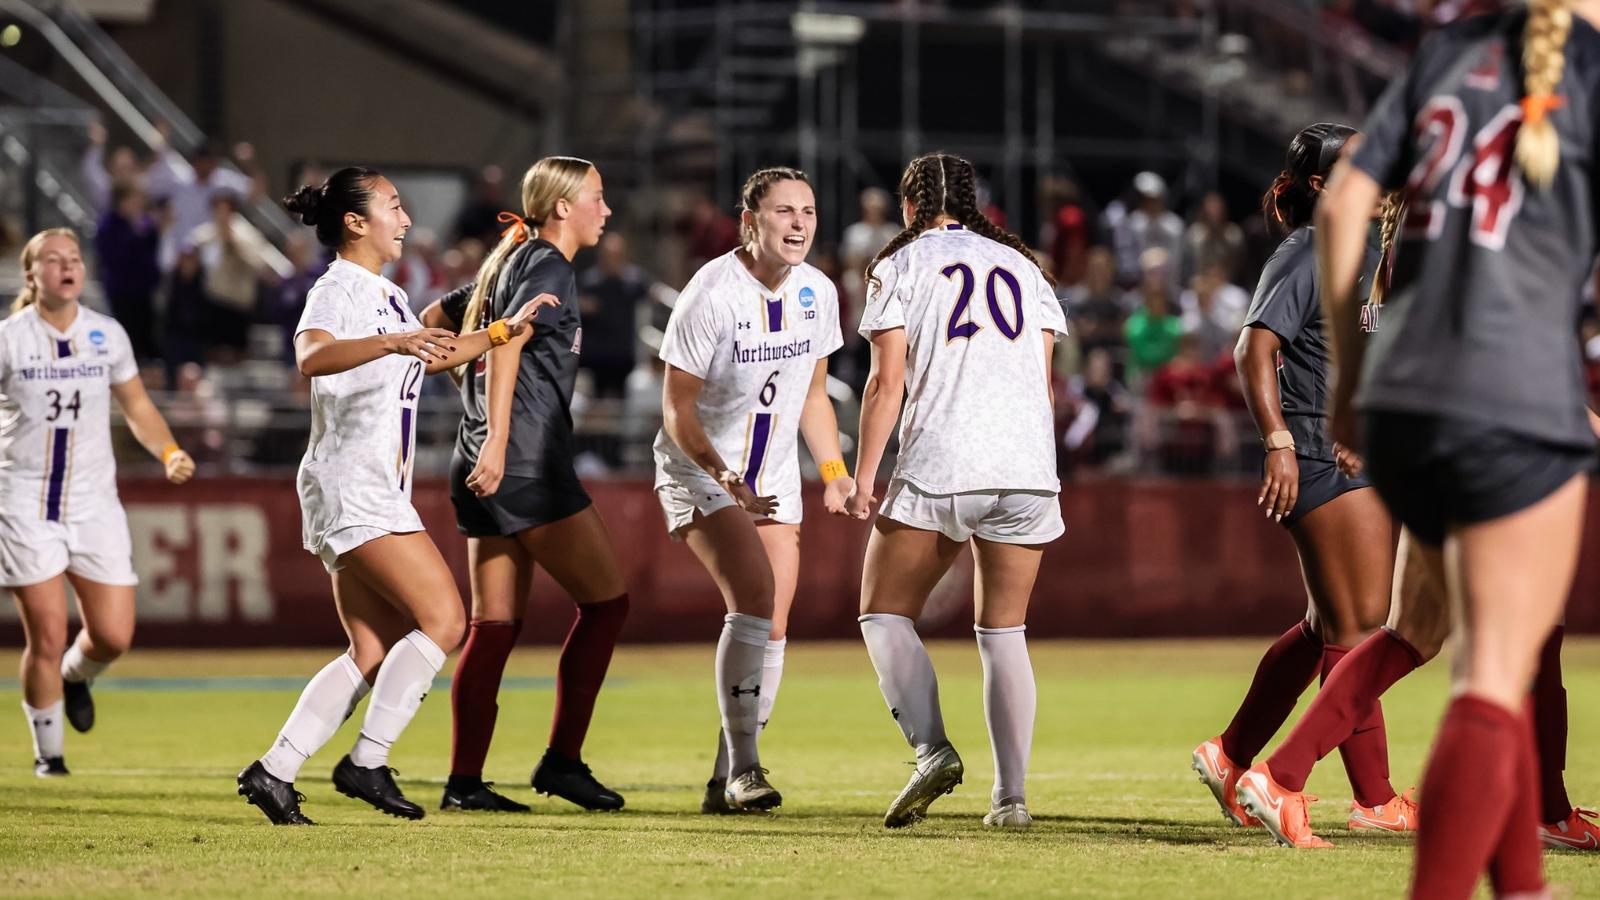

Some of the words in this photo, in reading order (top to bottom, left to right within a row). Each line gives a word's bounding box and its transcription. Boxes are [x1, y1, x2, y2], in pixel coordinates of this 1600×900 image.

[1403, 95, 1525, 251] 24
[938, 261, 1025, 346] 20
[732, 339, 811, 364] Northwestern
[400, 361, 422, 401] 12
[759, 370, 780, 407] 6
[45, 389, 82, 421] 34
